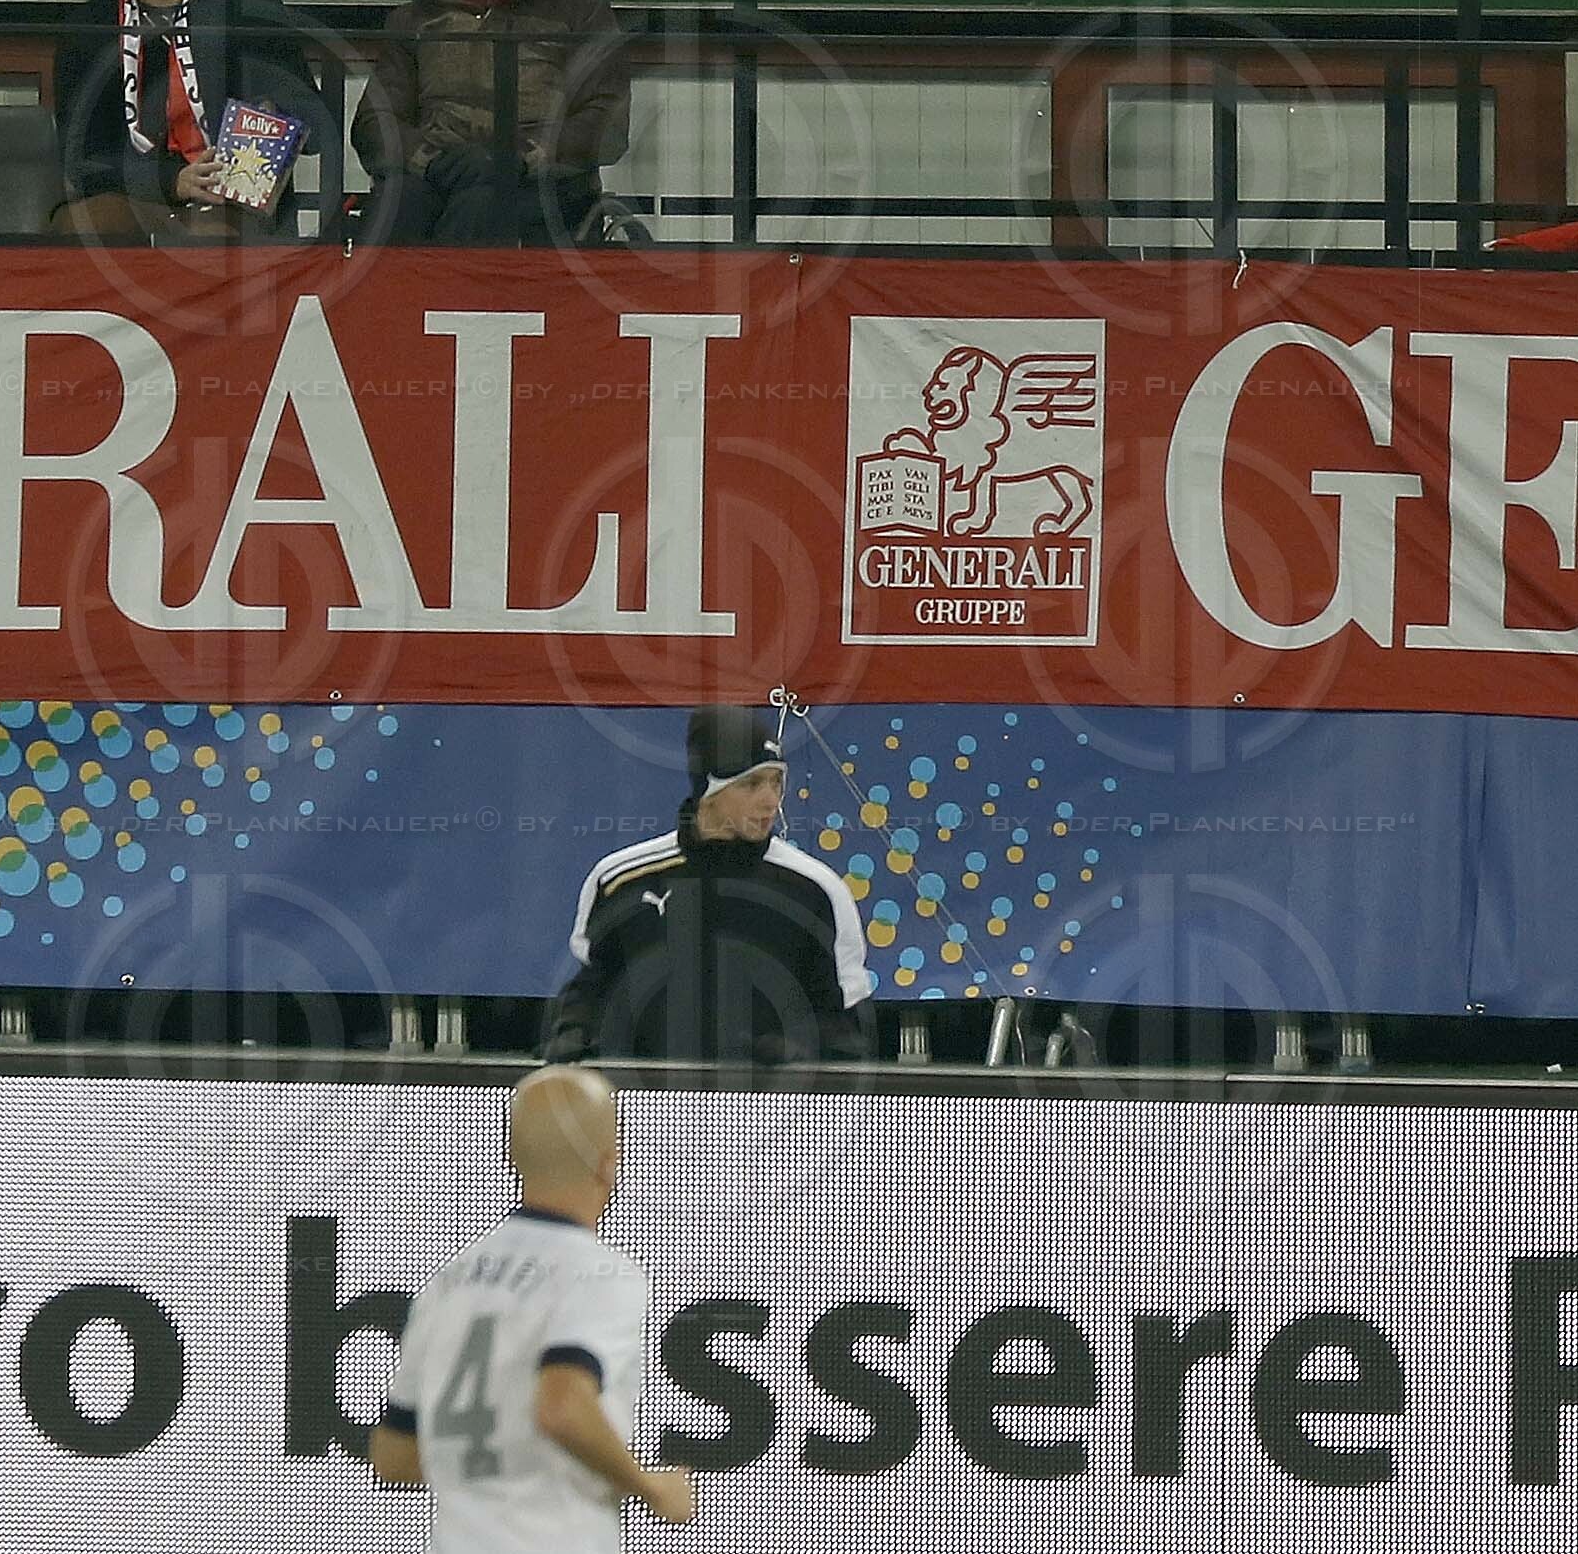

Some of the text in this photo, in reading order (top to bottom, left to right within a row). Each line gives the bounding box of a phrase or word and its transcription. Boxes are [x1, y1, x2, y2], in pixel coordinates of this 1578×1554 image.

[868, 469, 893, 482] PAX
[903, 468, 928, 481] VAN
[1165, 321, 1578, 656] GE
[904, 494, 926, 506] STA
[858, 545, 1087, 590] GENERALI
[914, 599, 1026, 625] GRUPPE
[285, 1216, 1406, 1487] bssere
[432, 1313, 502, 1481] 4
